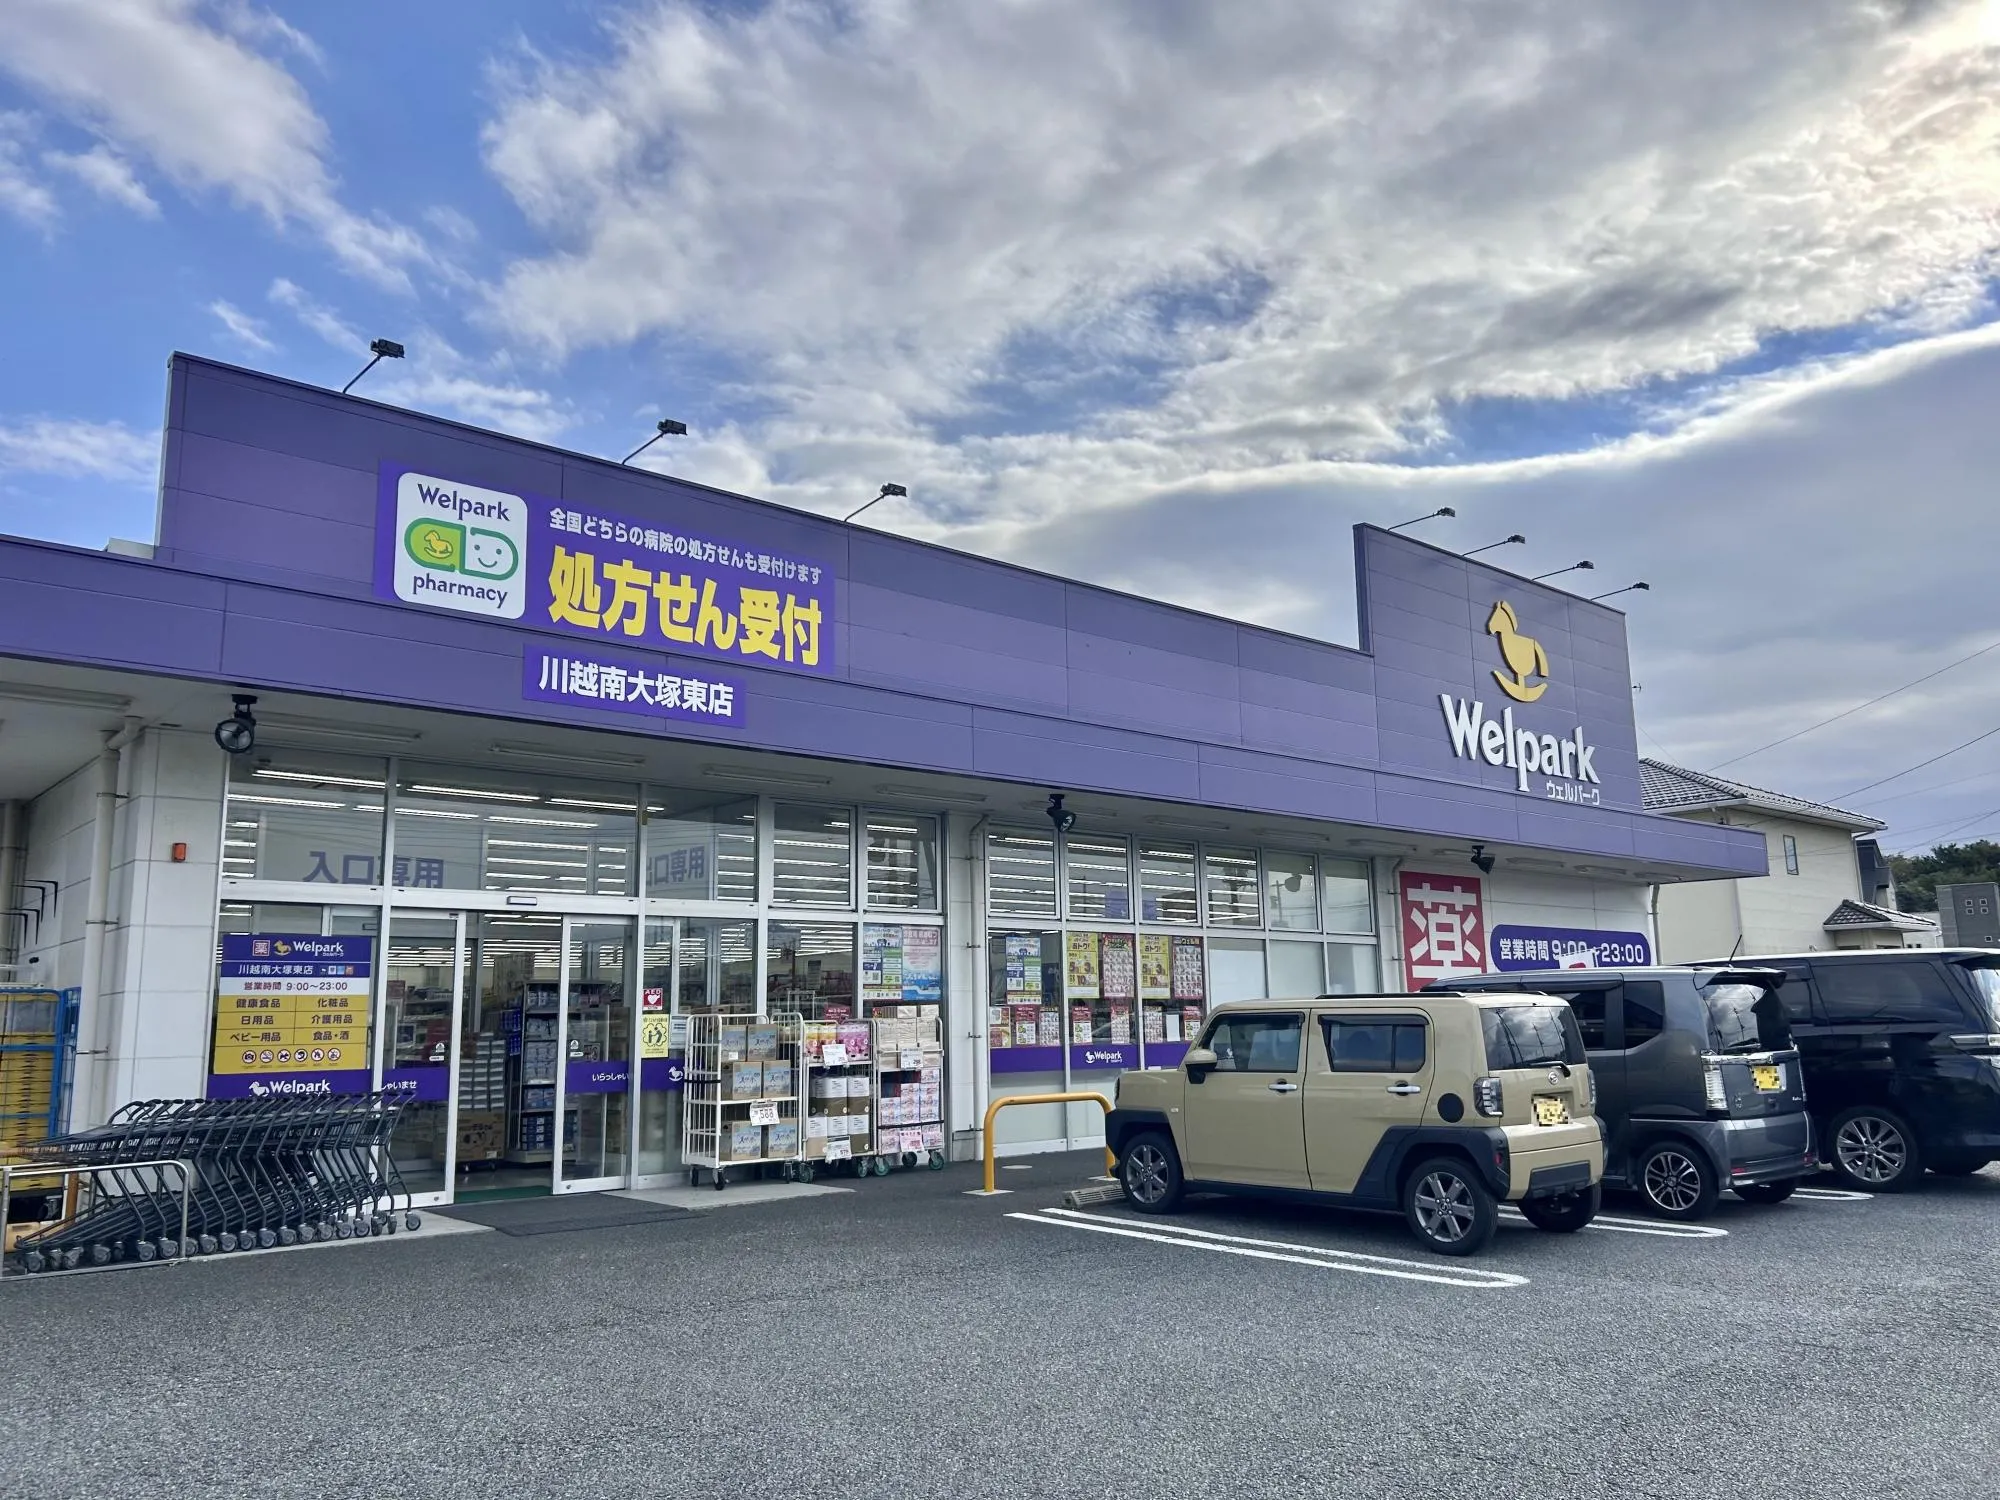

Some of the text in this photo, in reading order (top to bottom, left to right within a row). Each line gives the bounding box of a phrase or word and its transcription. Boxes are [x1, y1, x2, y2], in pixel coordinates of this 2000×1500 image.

[417, 484, 510, 521] Welpark
[549, 507, 822, 585] 全国どちらの病院の処方せんも受付けます
[412, 573, 508, 608] pharmacy
[548, 545, 822, 666] 処方せん受付
[539, 655, 734, 717] 川越南大塚東店
[1439, 694, 1600, 792] Welpark
[1407, 883, 1482, 980] 薬
[293, 941, 344, 956] Welpark
[1499, 938, 1550, 961] 営業時間
[238, 965, 313, 975] 川越南大塚東店
[244, 982, 281, 991] 営業時間
[236, 998, 349, 1008] 健康食品 化粧品
[241, 1014, 353, 1025] 日用品 介護用品
[1094, 1051, 1122, 1063] Welpark
[270, 1080, 331, 1093] Welpark
